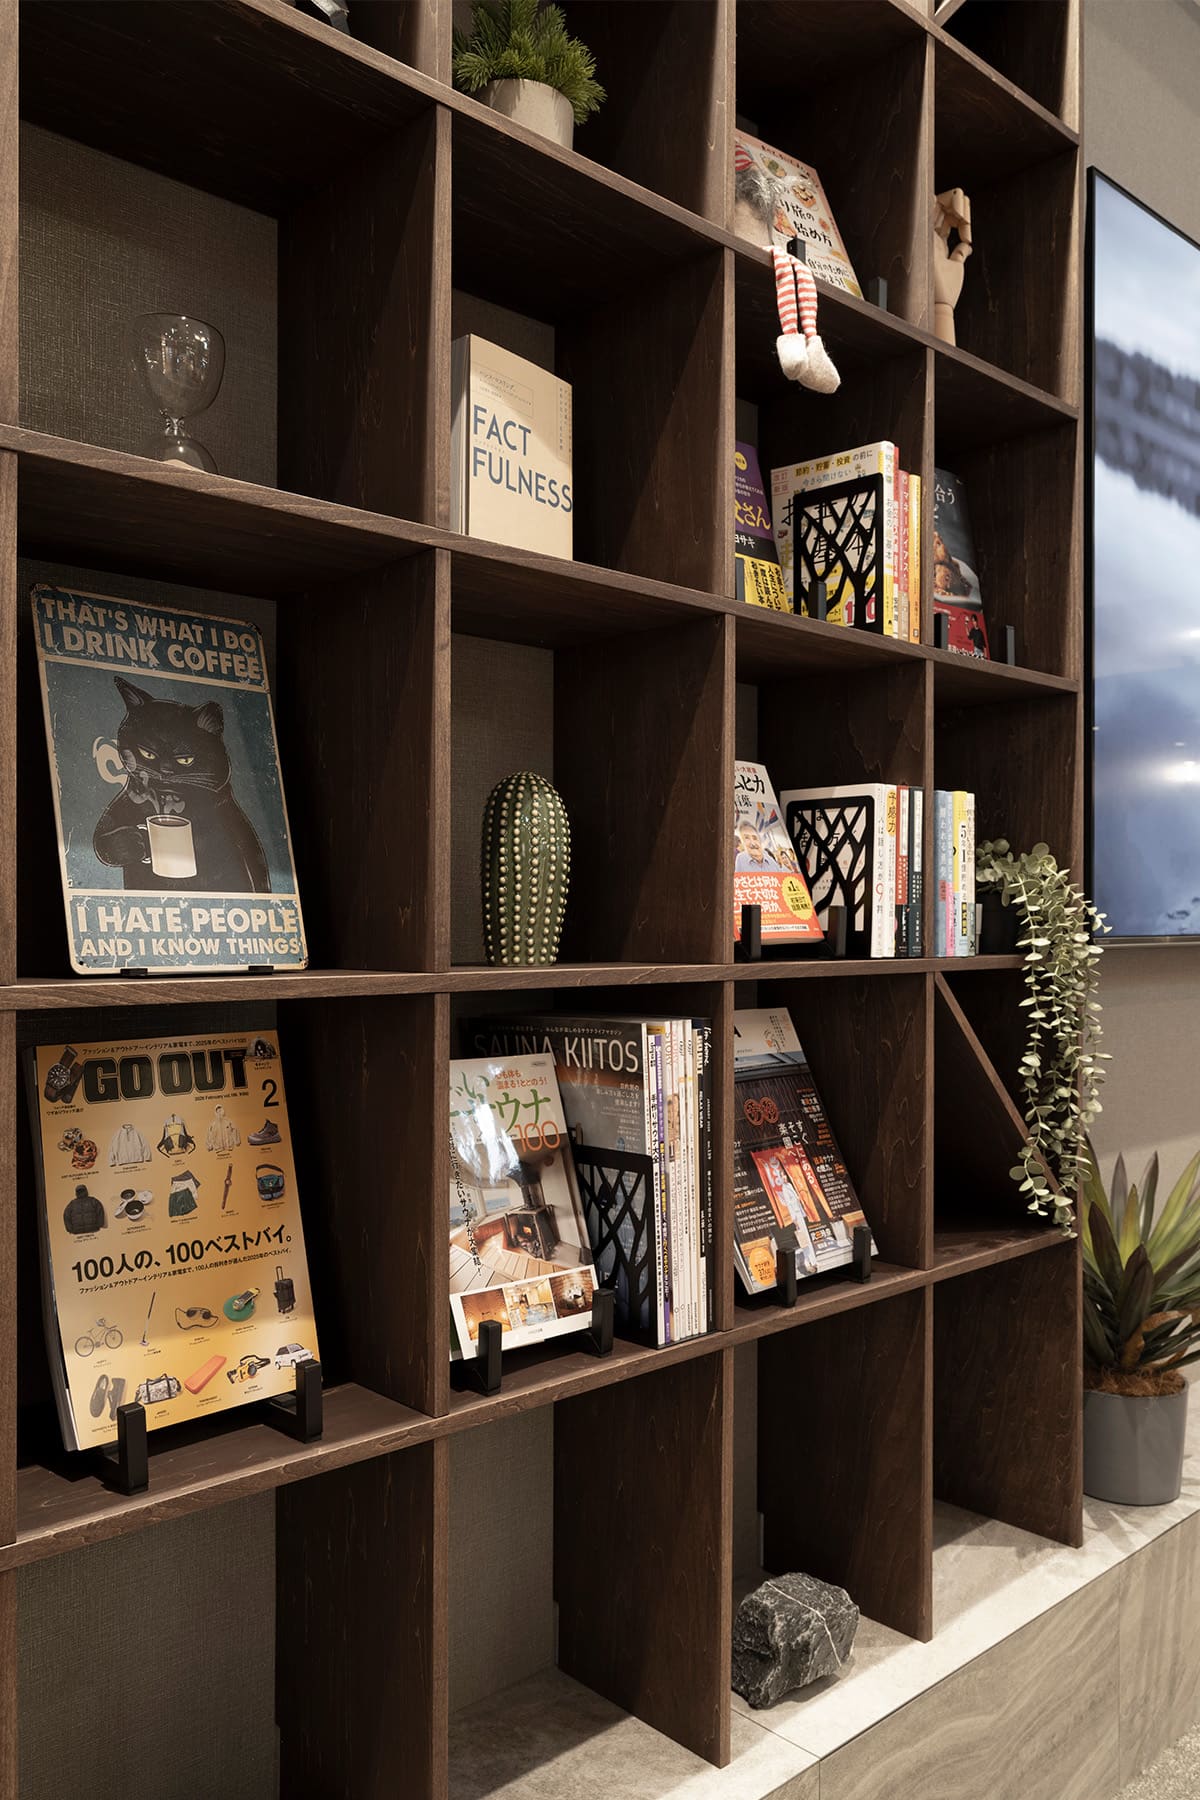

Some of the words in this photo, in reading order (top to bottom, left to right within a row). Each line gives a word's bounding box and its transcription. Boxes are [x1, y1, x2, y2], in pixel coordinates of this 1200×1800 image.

[473, 404, 531, 456] FACT
[473, 447, 573, 513] FULNESS
[43, 598, 129, 631] THAT'S
[135, 613, 205, 645] WHAT
[211, 626, 218, 647] I
[223, 628, 256, 654] DO
[45, 626, 53, 650] I
[62, 628, 160, 669] DRINK
[167, 643, 263, 681] COFFEE
[77, 906, 89, 933] I
[97, 906, 185, 934] HATE
[191, 905, 299, 935] PEOPLE
[80, 938, 132, 957] AND
[139, 938, 146, 957] I
[152, 938, 221, 957] KNOW
[226, 937, 301, 956] THINGS
[82, 1053, 155, 1104] GO
[158, 1047, 249, 1098] OUT
[564, 1034, 640, 1073] KIITOS
[261, 1078, 280, 1108] 2
[514, 1120, 561, 1153] 100
